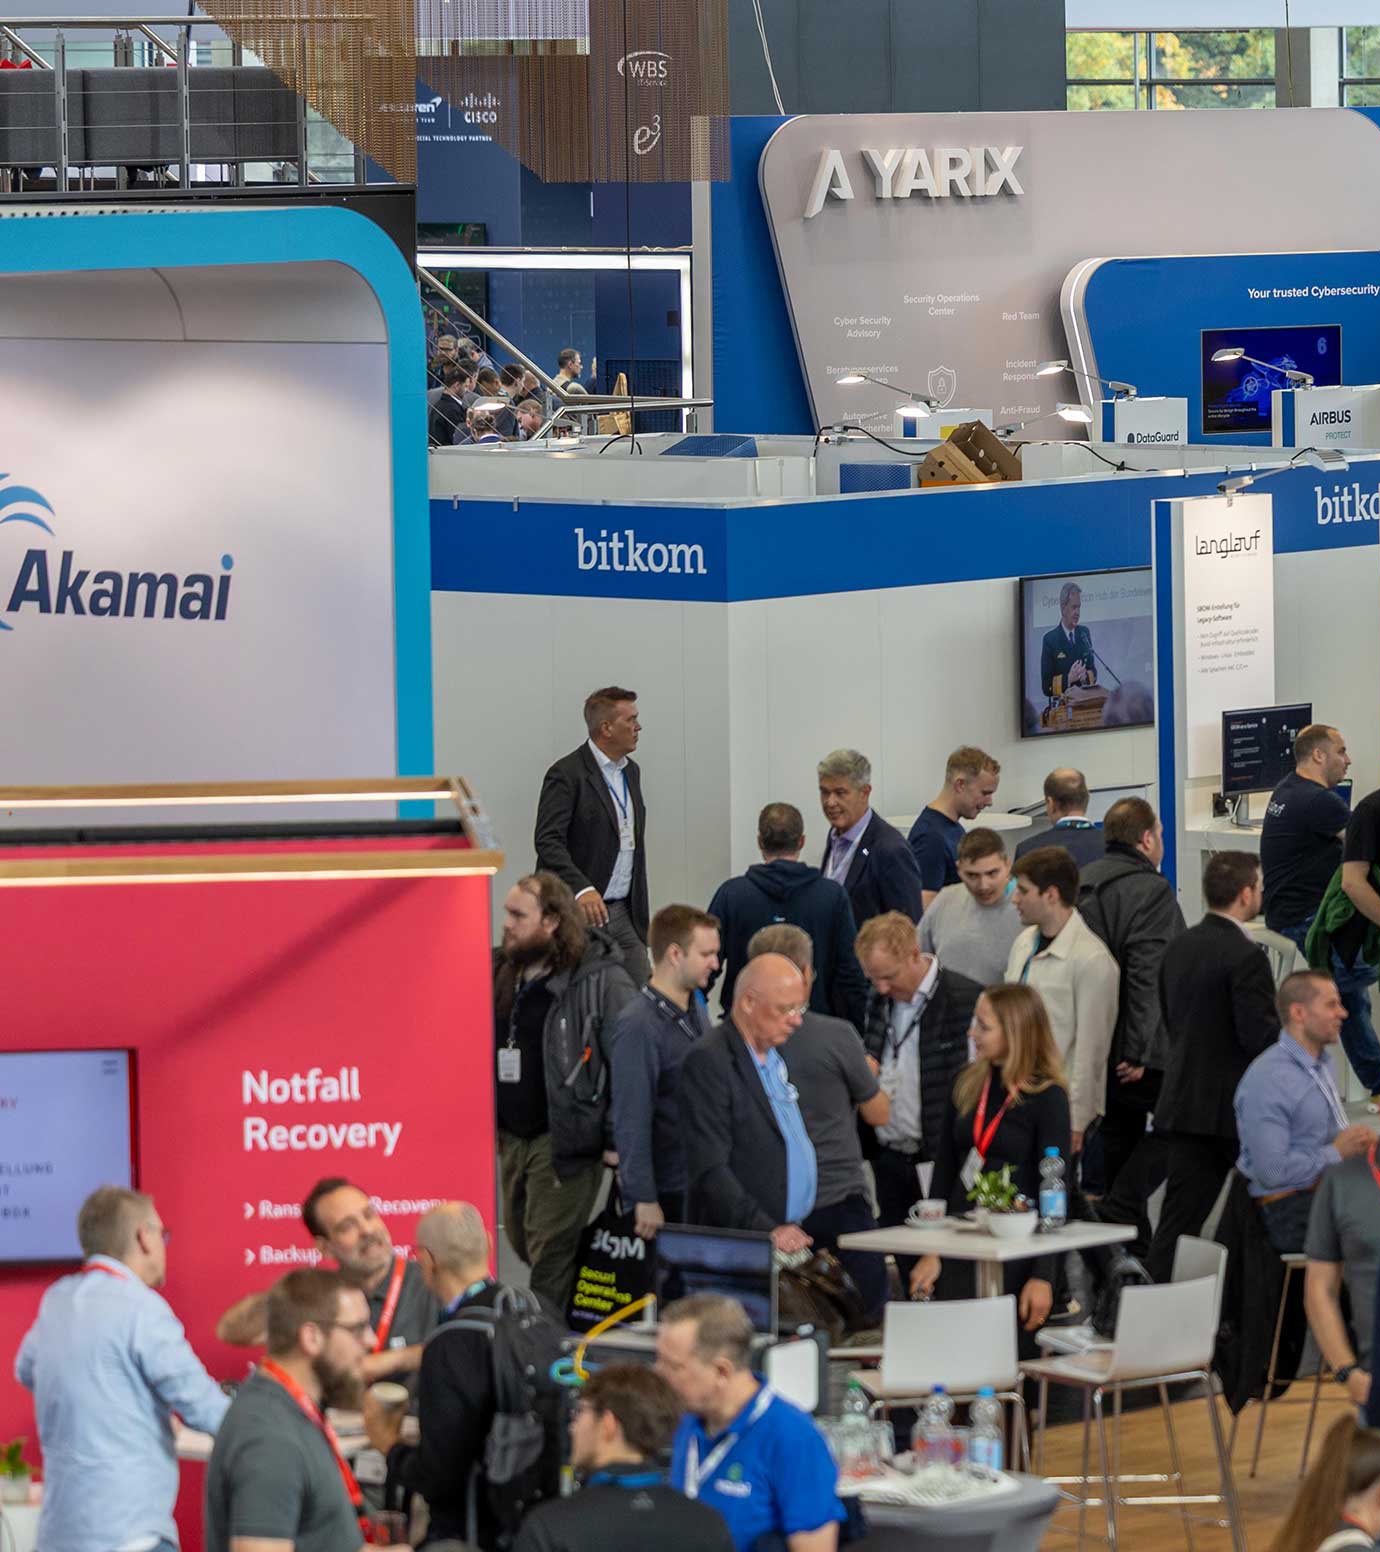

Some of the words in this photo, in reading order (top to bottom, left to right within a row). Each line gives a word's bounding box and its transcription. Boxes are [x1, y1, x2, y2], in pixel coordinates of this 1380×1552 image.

[629, 60, 668, 78] WBS
[464, 111, 497, 124] CISCO
[861, 146, 1025, 199] YARIX
[903, 293, 936, 305] Security
[937, 292, 980, 304] Operations
[1247, 287, 1269, 300] Your
[1272, 285, 1309, 299] trusted
[1311, 283, 1380, 299] Cybersecurity
[928, 306, 955, 317] Center
[1002, 311, 1018, 321] Red
[1020, 311, 1040, 321] Team
[833, 316, 859, 327] Cyber
[861, 315, 892, 328] Security
[846, 328, 881, 340] Advisory
[1317, 337, 1328, 355] 6
[1006, 360, 1037, 369] Incident
[1000, 405, 1041, 415] Anti-Fraud
[1309, 409, 1352, 427] AIRBUS
[1136, 431, 1180, 444] DataGuard
[1325, 430, 1352, 441] PROTECT
[1314, 482, 1380, 526] bitko
[574, 527, 708, 575] bitkom
[1195, 529, 1261, 560] langlauf
[7, 549, 234, 621] Akamai
[242, 1066, 361, 1105] Notfall
[243, 1118, 403, 1156] Recovery
[259, 1245, 323, 1267] Backup
[579, 1265, 617, 1285] Securi
[573, 1292, 615, 1313] Center
